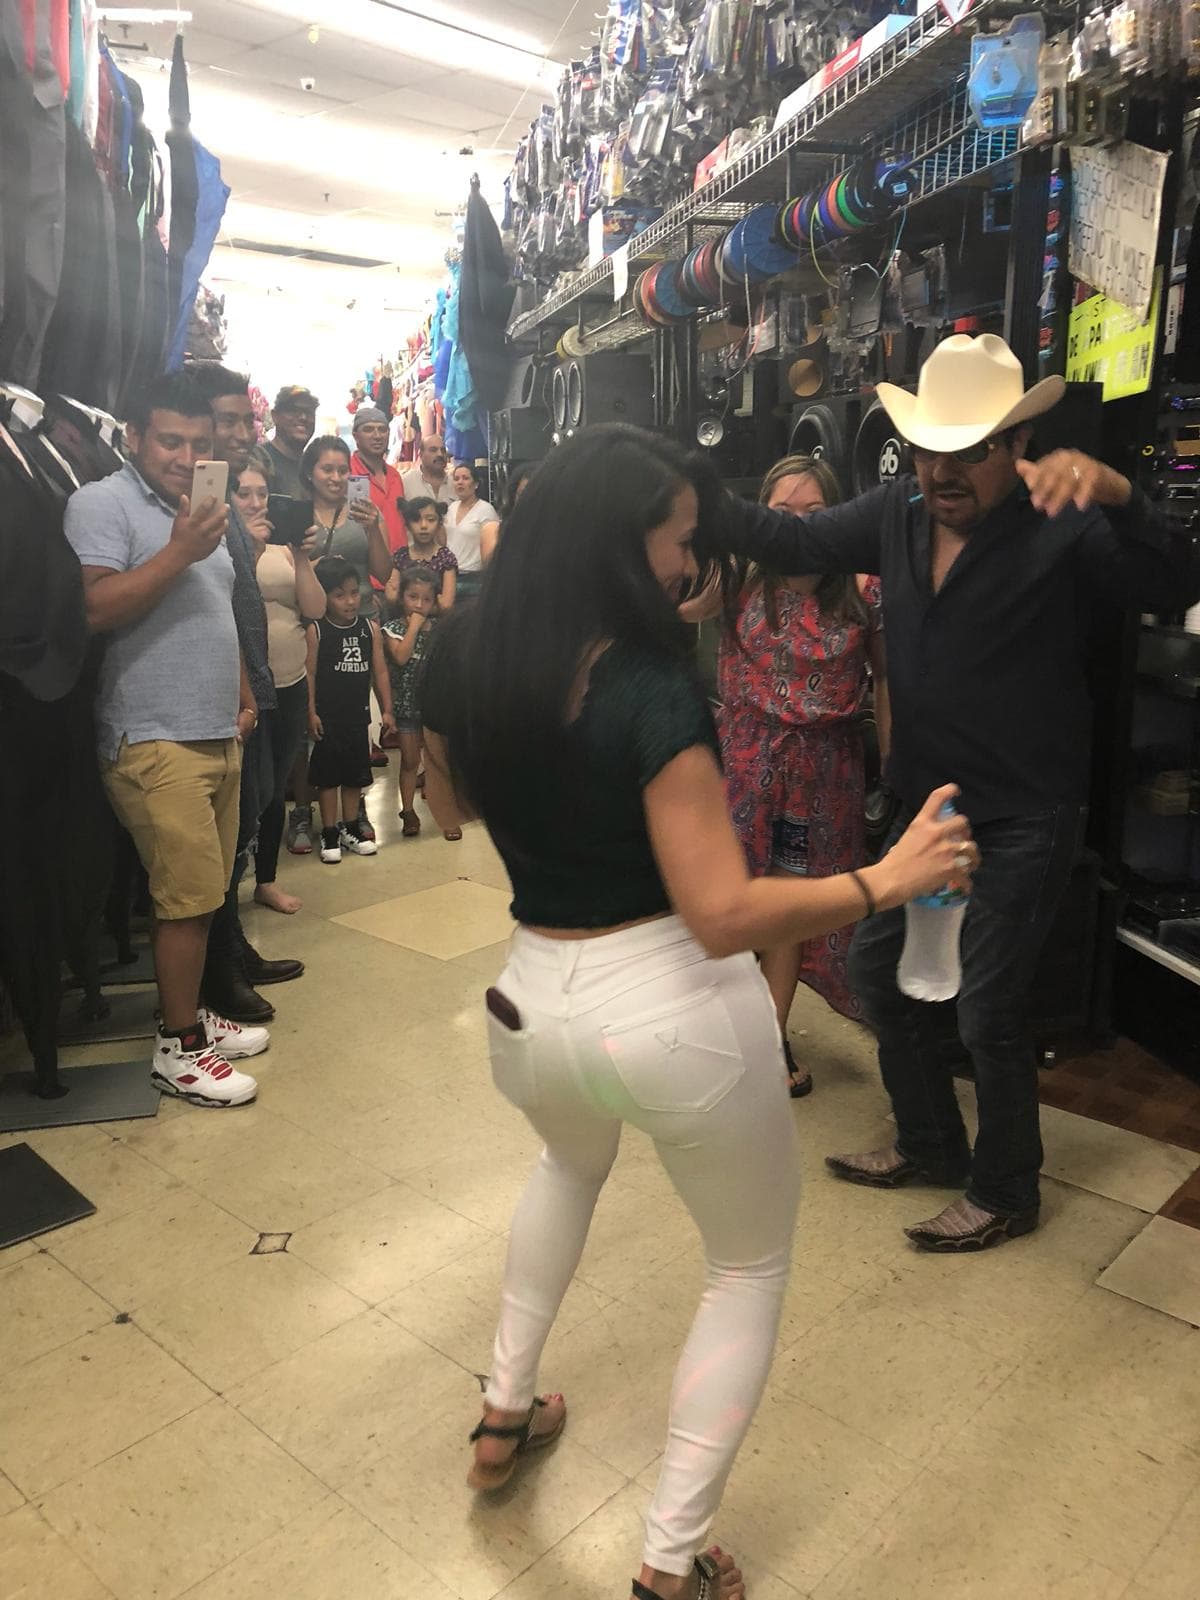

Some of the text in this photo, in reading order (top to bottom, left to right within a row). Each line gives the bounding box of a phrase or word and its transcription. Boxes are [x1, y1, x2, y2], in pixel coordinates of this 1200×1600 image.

[342, 637, 359, 647] AIR
[342, 647, 362, 662] 23
[334, 661, 369, 672] JORDAN
